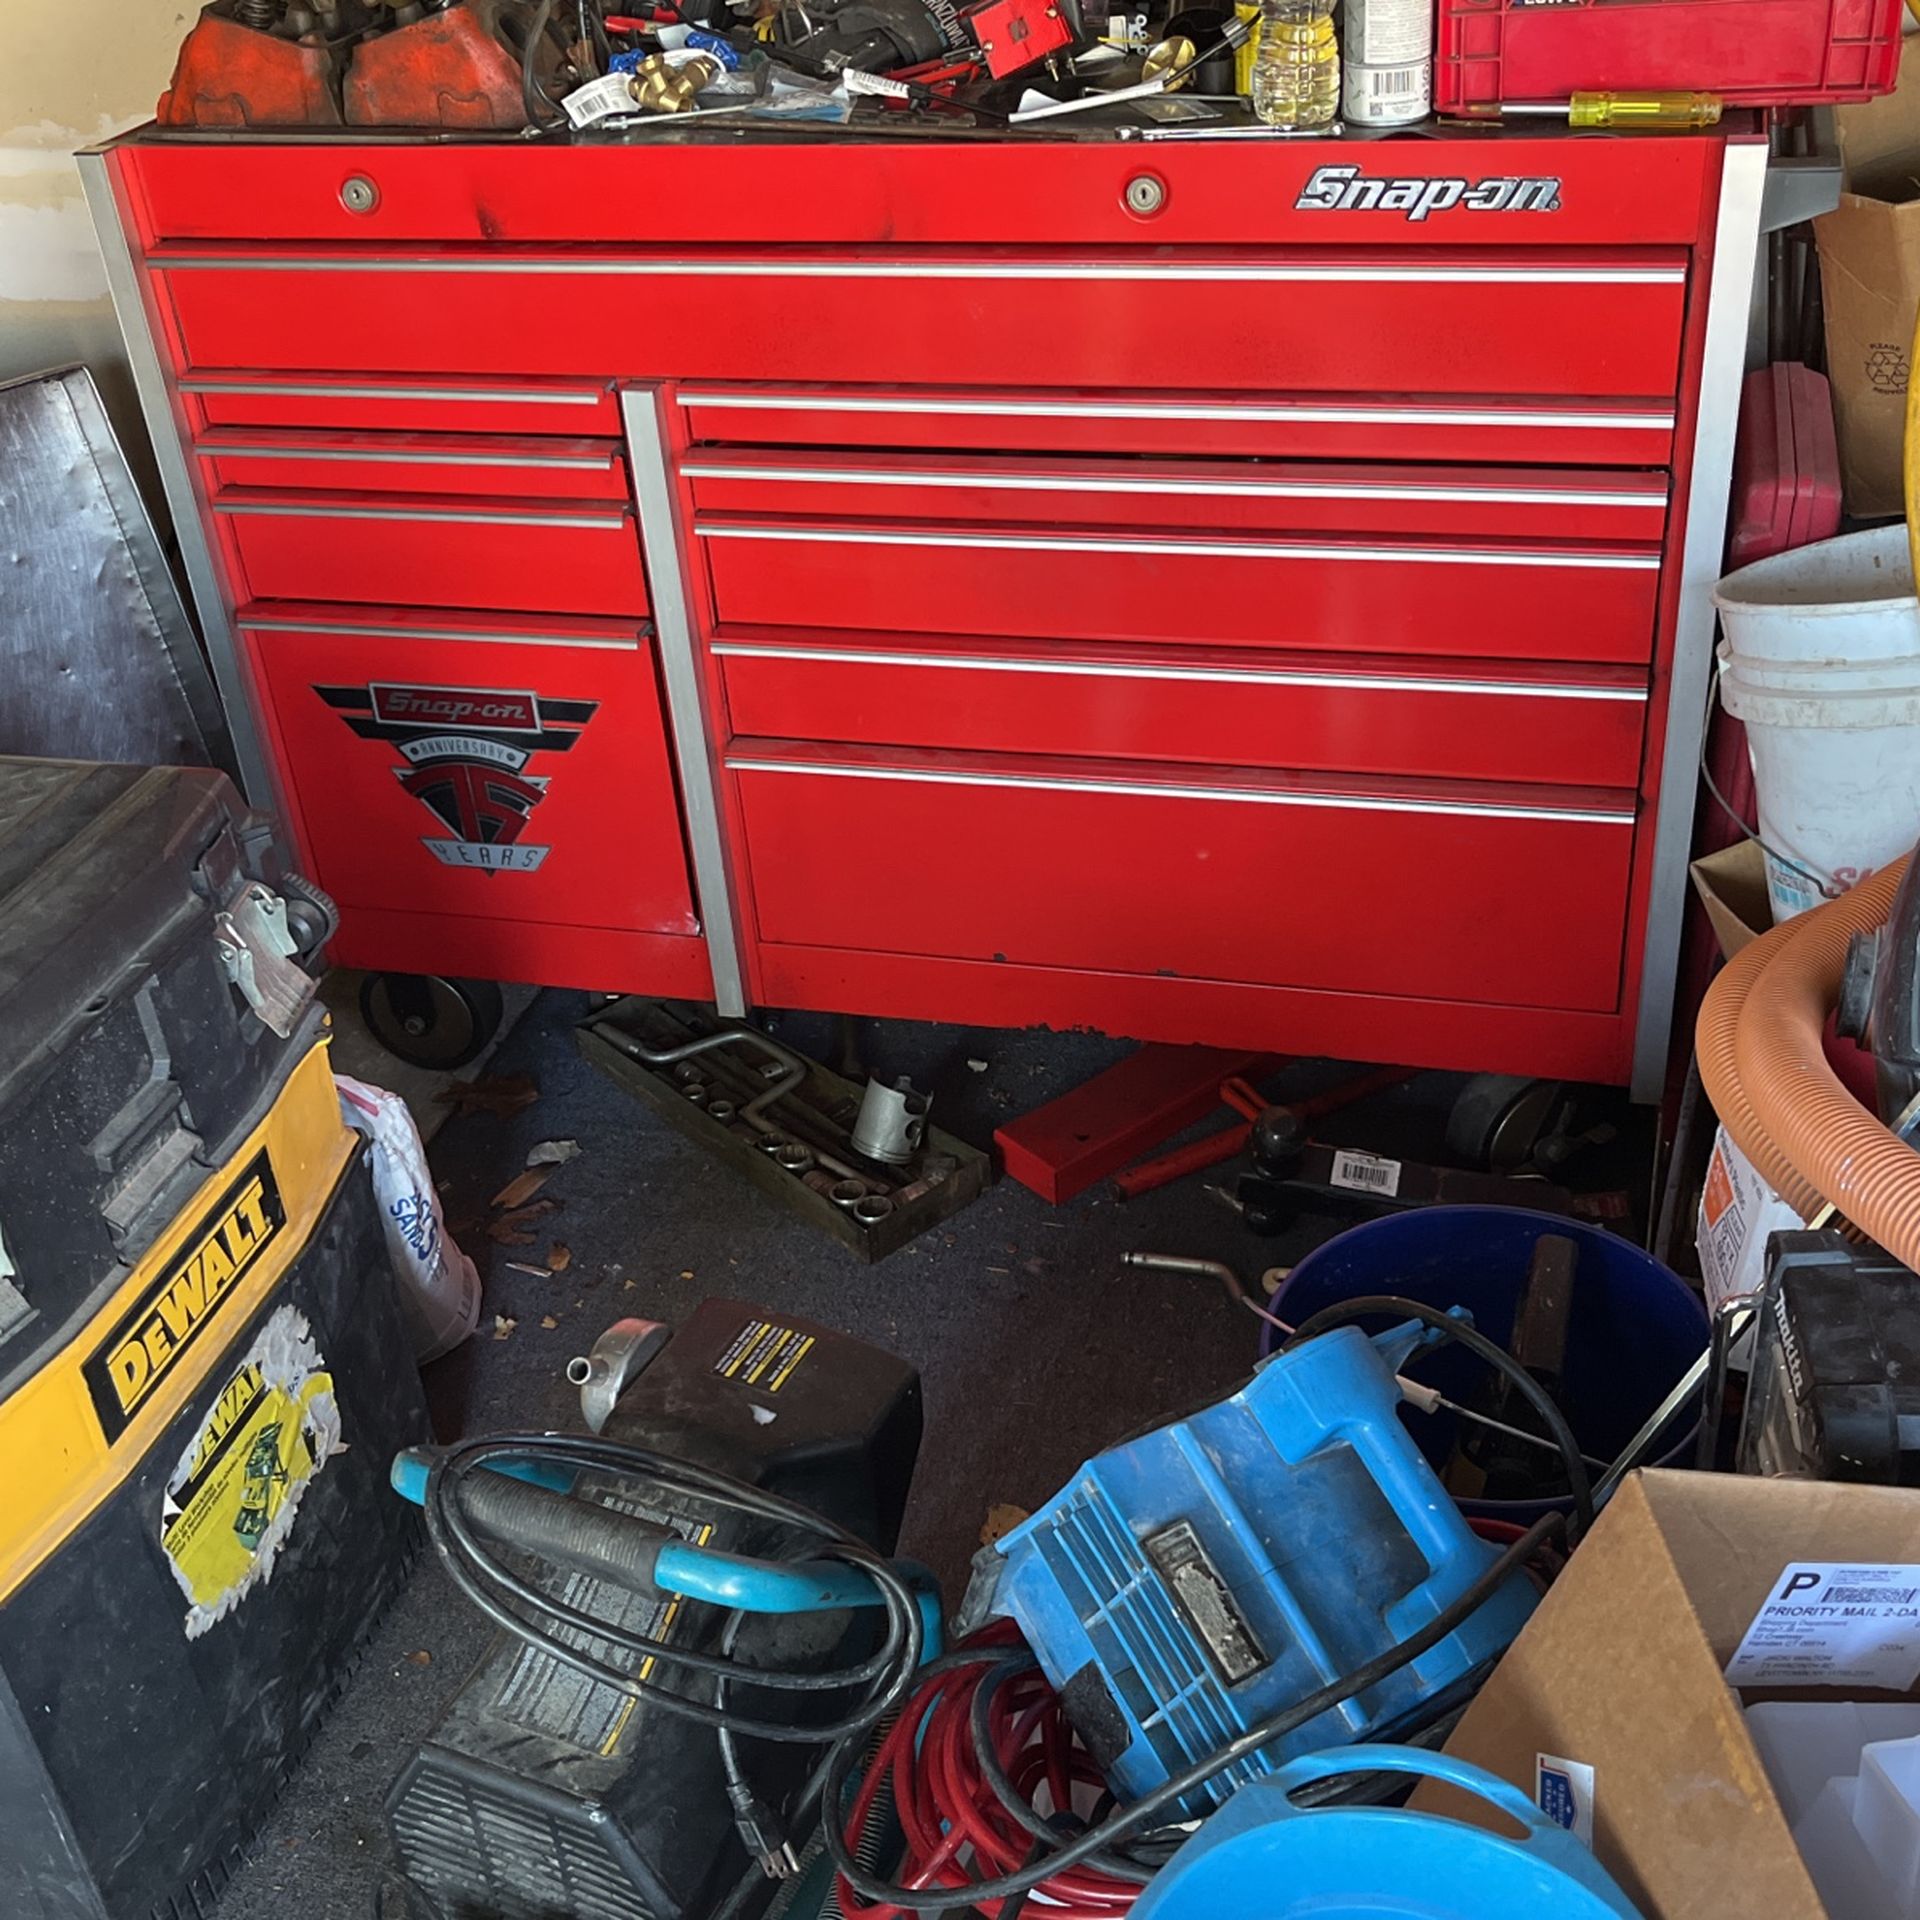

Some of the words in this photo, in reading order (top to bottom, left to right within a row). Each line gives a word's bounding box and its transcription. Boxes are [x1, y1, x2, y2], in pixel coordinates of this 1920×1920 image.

[1295, 165, 1560, 222] Snap-on
[385, 692, 527, 721] Snap-on
[419, 739, 506, 758] ANNIVERSARY
[432, 842, 538, 868] YEARS
[390, 1199, 425, 1249] SAND
[107, 1179, 270, 1411] DEWALT
[1774, 1287, 1803, 1398] makita
[1780, 1573, 1820, 1600] P
[1764, 1606, 1838, 1617] PRIORITY
[1840, 1607, 1877, 1616] MAIL
